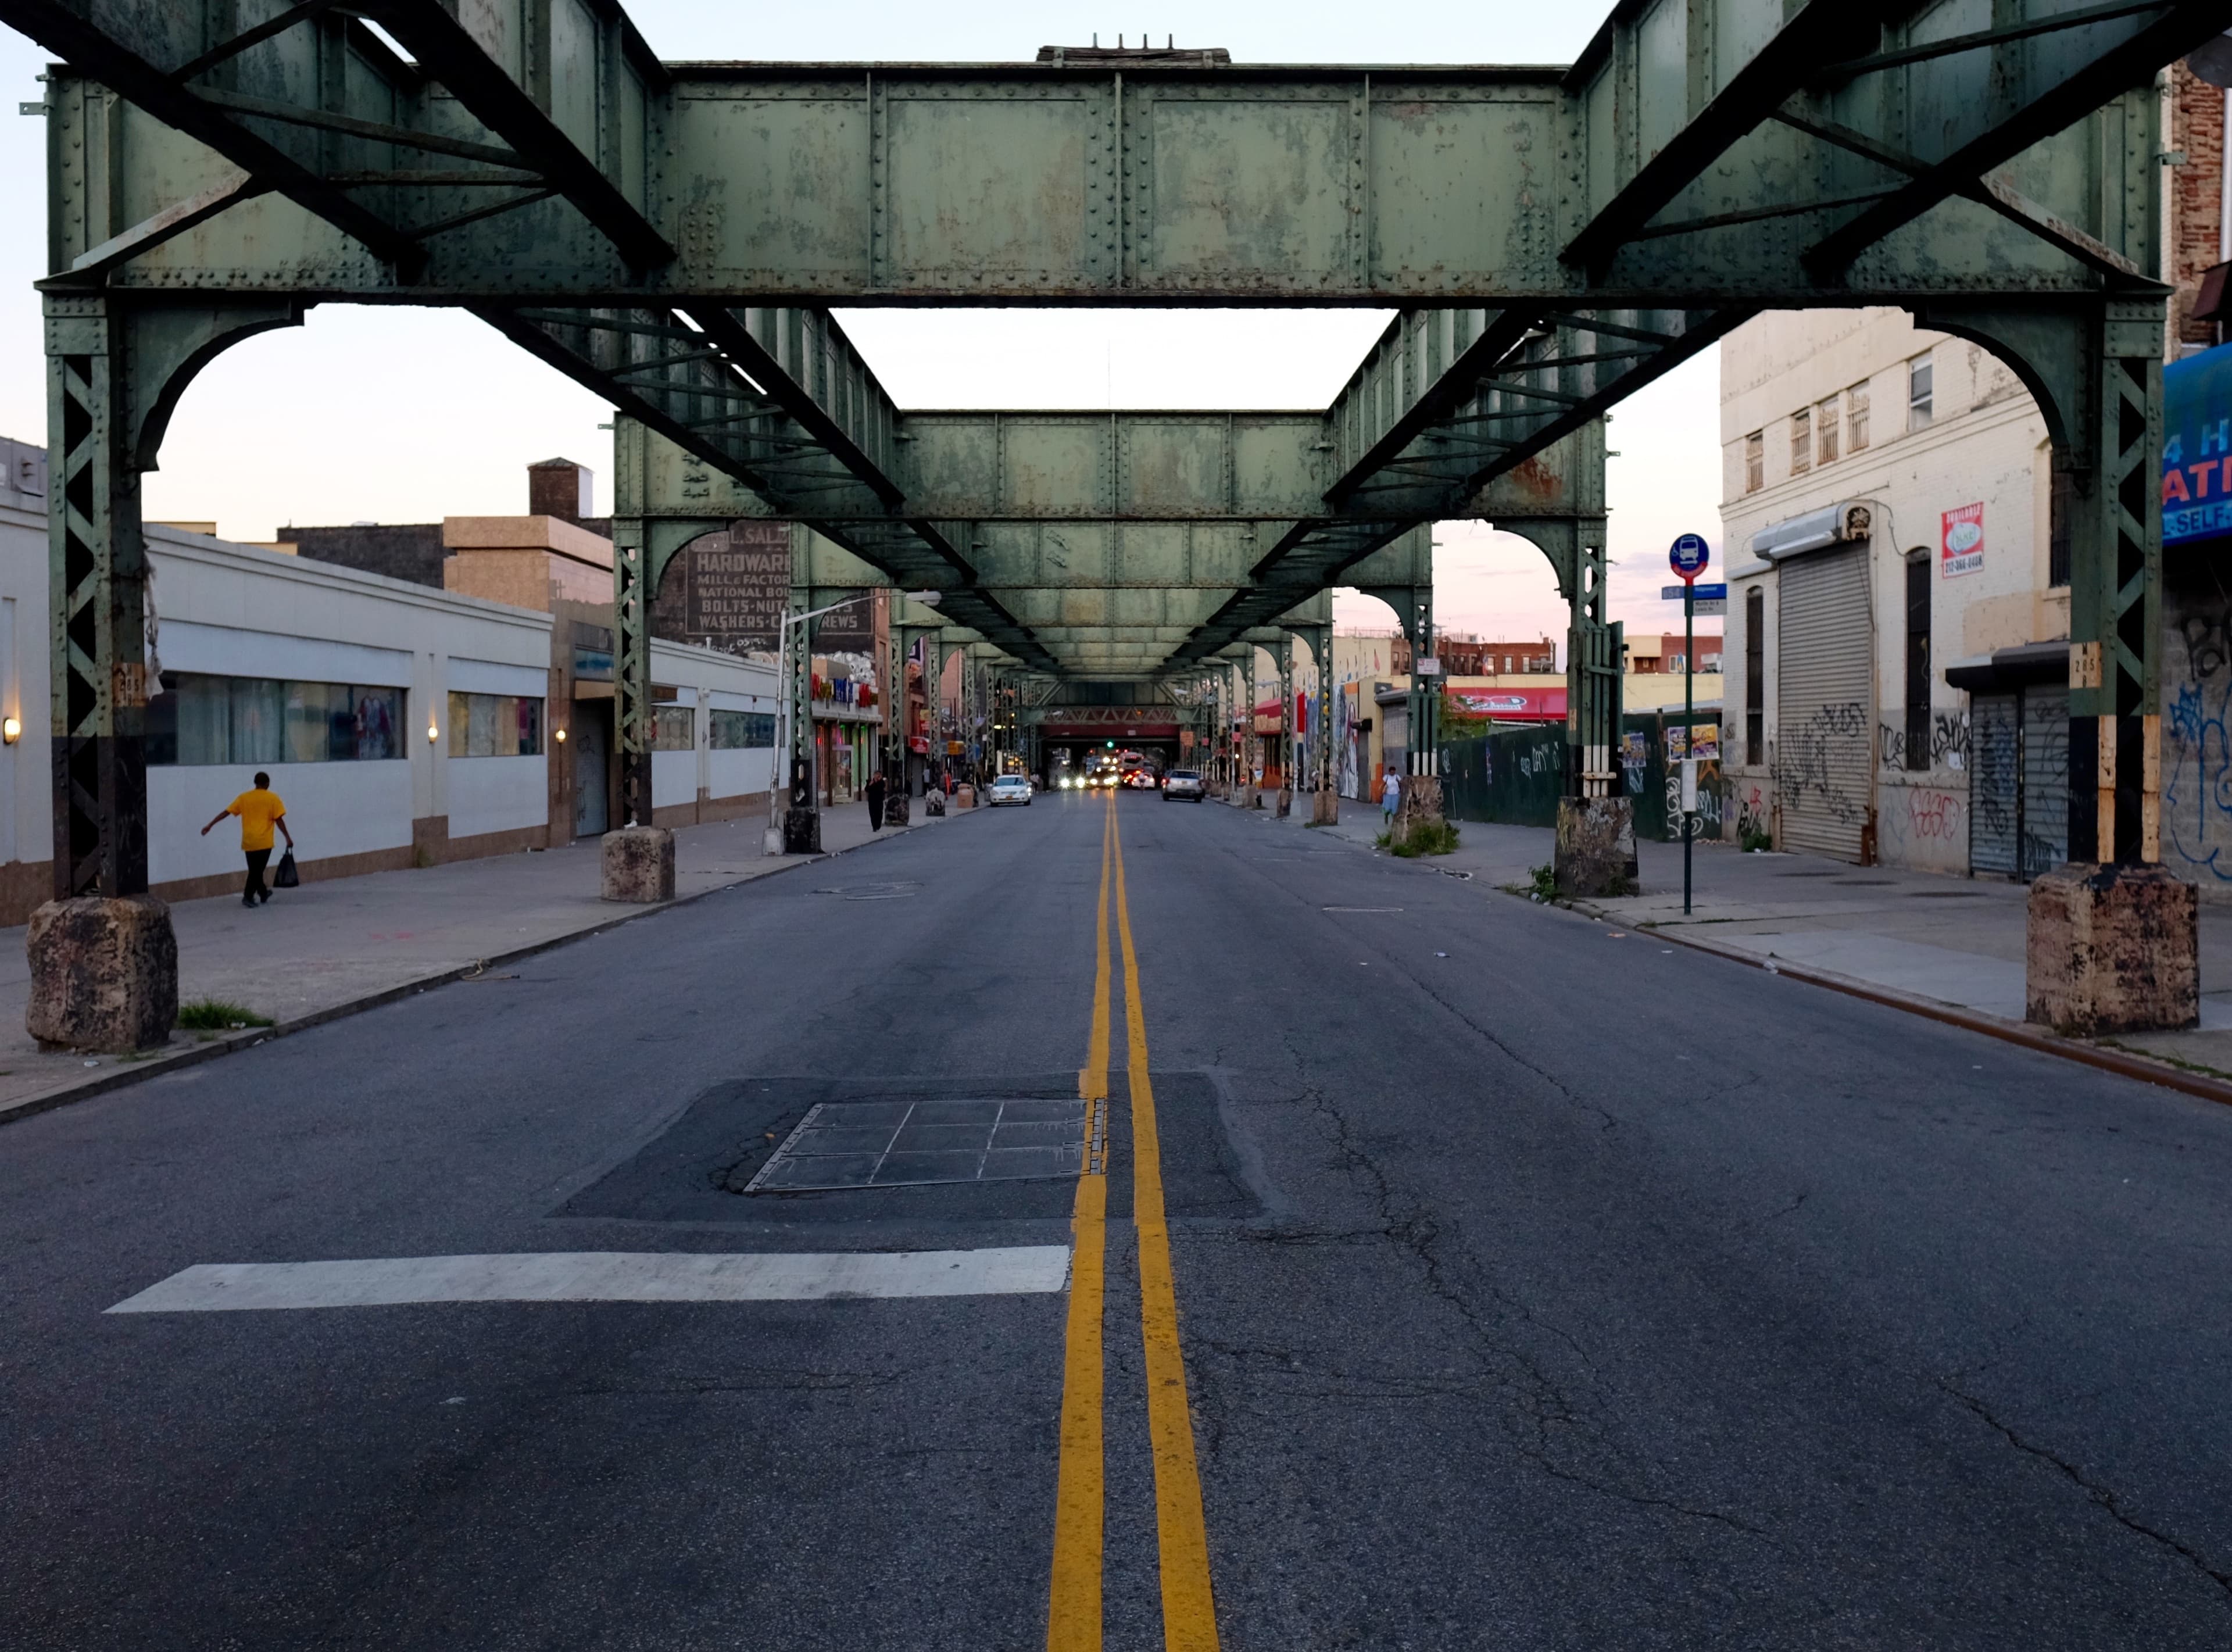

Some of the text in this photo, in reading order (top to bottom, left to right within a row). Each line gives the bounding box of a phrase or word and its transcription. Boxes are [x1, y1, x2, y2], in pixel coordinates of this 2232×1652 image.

[698, 574, 733, 585] MILL
[698, 588, 763, 597] NATIONAL
[2075, 657, 2095, 673] 285
